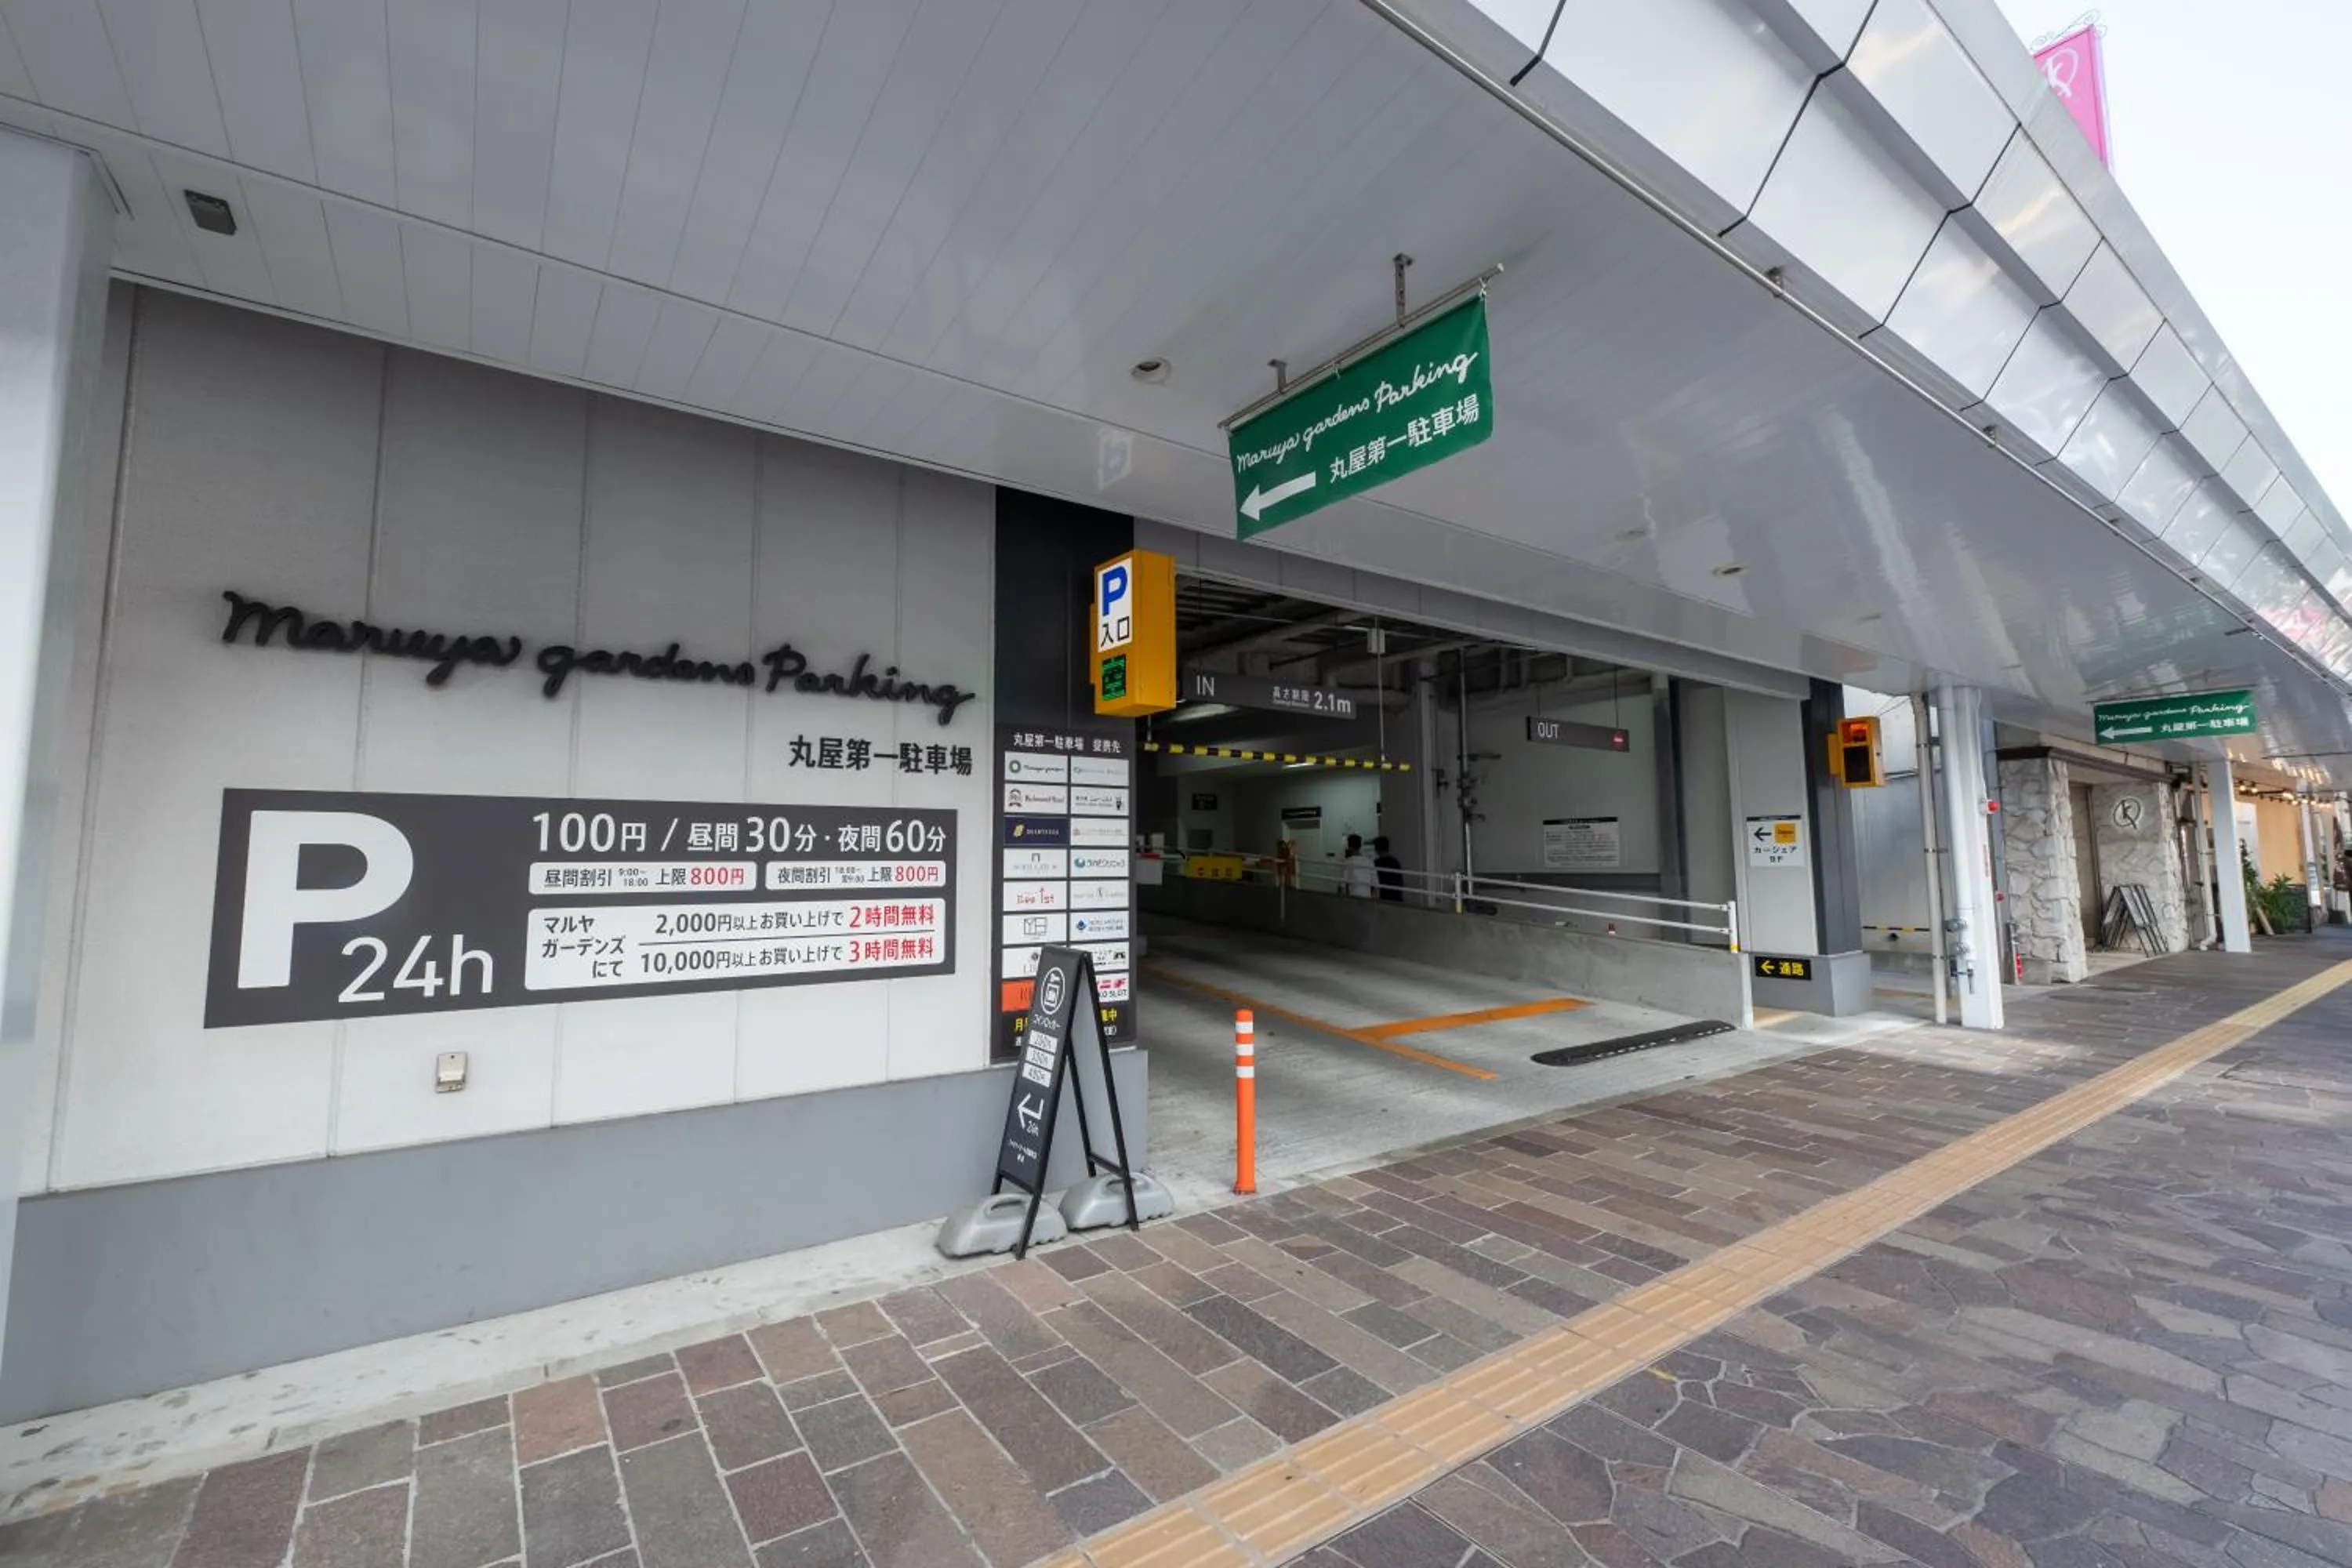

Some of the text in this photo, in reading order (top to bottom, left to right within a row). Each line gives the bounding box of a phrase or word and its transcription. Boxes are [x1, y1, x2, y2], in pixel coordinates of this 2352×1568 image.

[1303, 397, 1370, 452] gardens
[1374, 351, 1479, 413] Parking
[1330, 393, 1481, 483] 丸屋第一駐車場
[1102, 565, 1128, 617] P
[1100, 616, 1130, 648] 入口
[537, 642, 755, 698] gardens
[762, 643, 976, 725] Parking
[1196, 674, 1215, 696] IN
[1314, 691, 1352, 714] 2.1m
[1537, 721, 1560, 739] OUT
[788, 735, 972, 776] 丸屋第一駐車場
[532, 811, 647, 853] 100円
[543, 866, 744, 888] 昼間割引 上限800円
[777, 866, 939, 884] 夜間割引 上限800円
[238, 810, 414, 989] P
[543, 915, 595, 934] マルヤ
[849, 904, 935, 929] 2時間無料
[542, 935, 626, 958] ガーデンズ
[848, 937, 934, 963] 3時間無料
[338, 934, 494, 1004] 24h
[592, 960, 624, 978] にて
